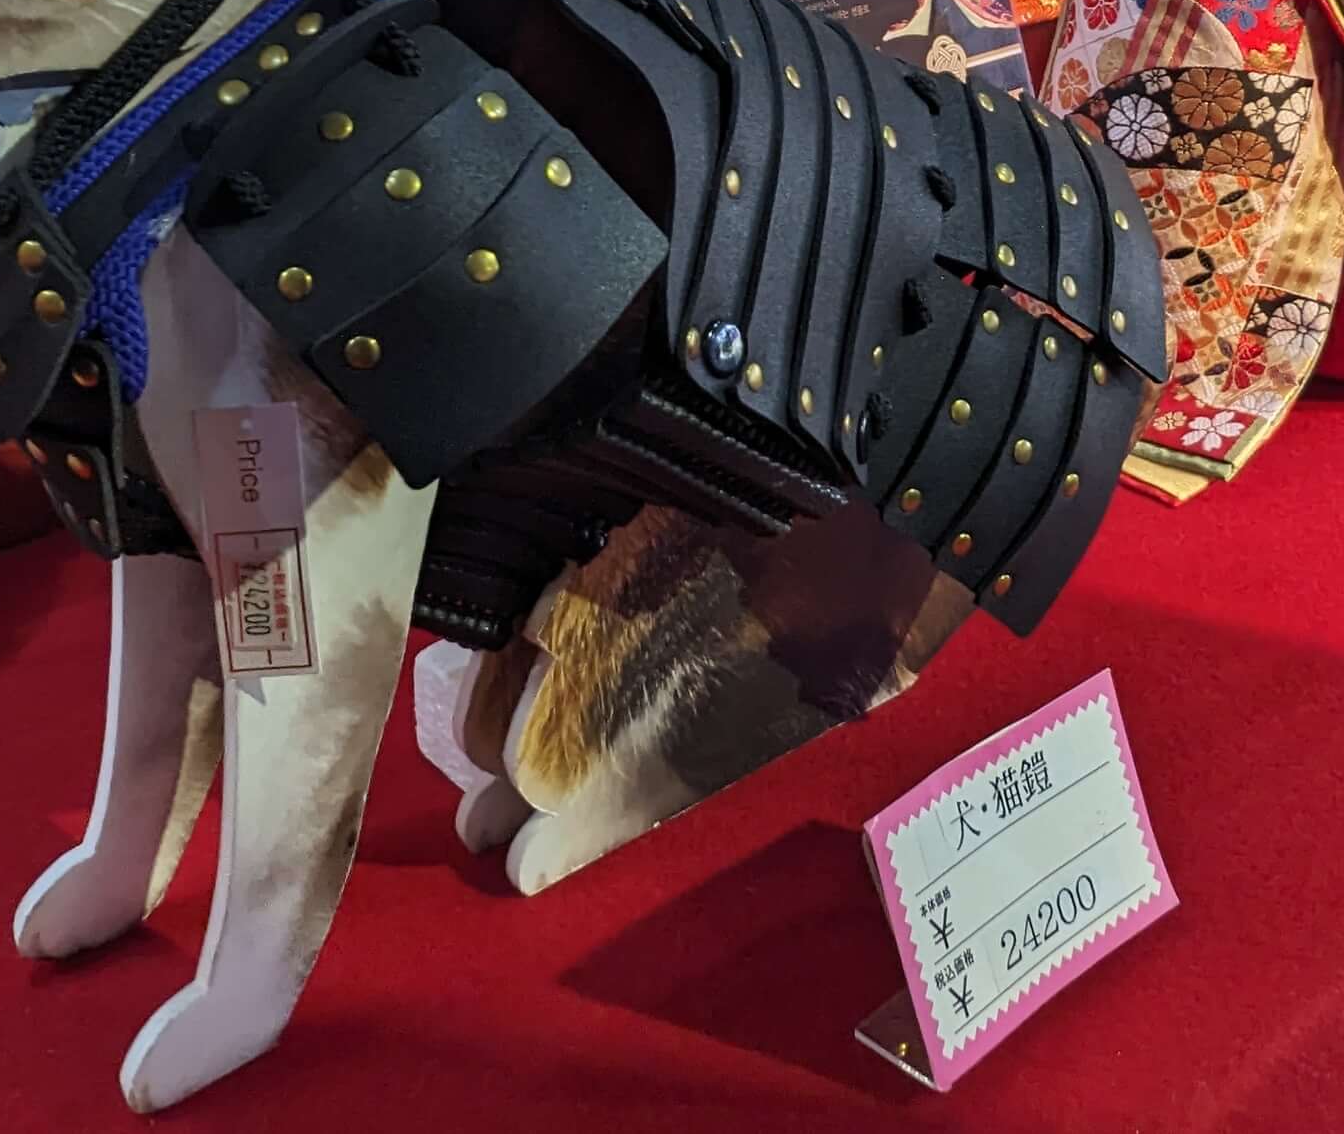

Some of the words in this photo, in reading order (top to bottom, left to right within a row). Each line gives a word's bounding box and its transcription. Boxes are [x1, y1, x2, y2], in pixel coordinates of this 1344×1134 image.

[236, 438, 264, 504] Price
[919, 884, 952, 918] 本体価格
[1000, 873, 1098, 972] 24200
[929, 906, 955, 950] ¥
[933, 947, 975, 992] 税込価格
